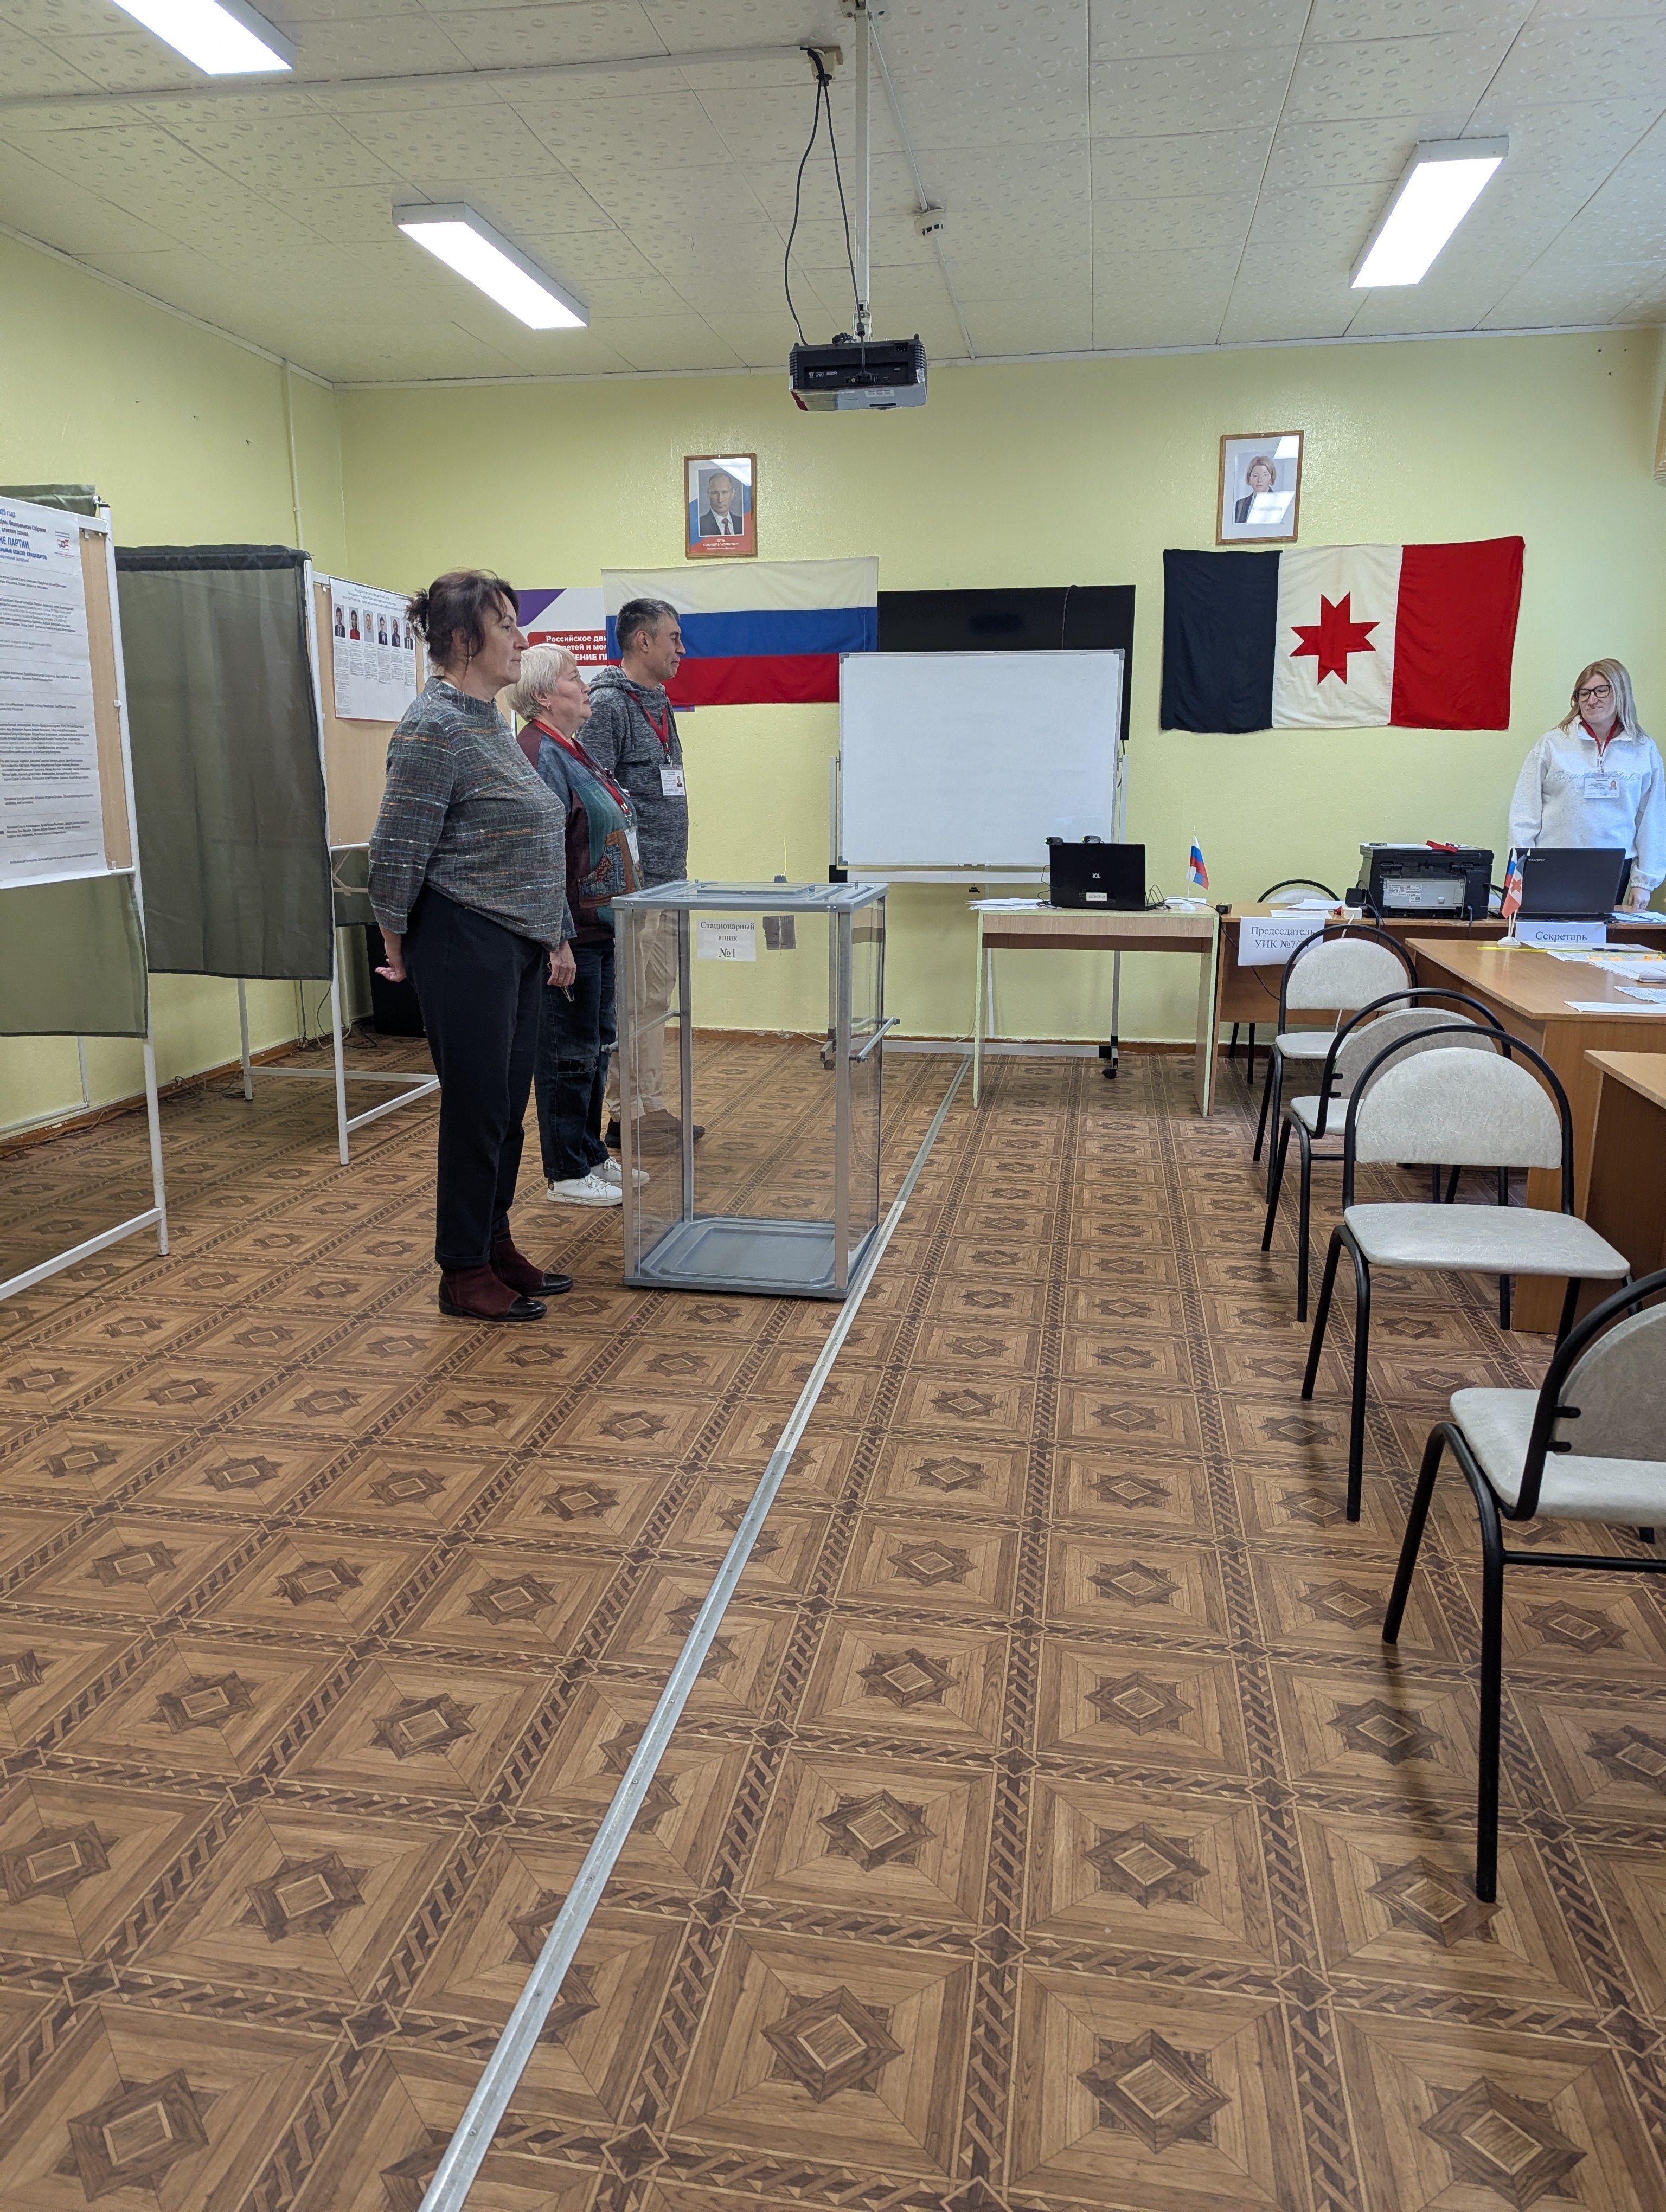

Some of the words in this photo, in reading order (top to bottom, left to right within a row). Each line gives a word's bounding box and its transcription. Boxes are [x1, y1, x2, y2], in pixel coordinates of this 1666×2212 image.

[8, 537, 31, 551] ПАРТИИ,
[701, 921, 755, 931] Стационарный
[1251, 927, 1315, 936] Председатель
[1535, 931, 1587, 942] Секретарь
[1254, 940, 1277, 948] УИК
[718, 948, 736, 958] №1
